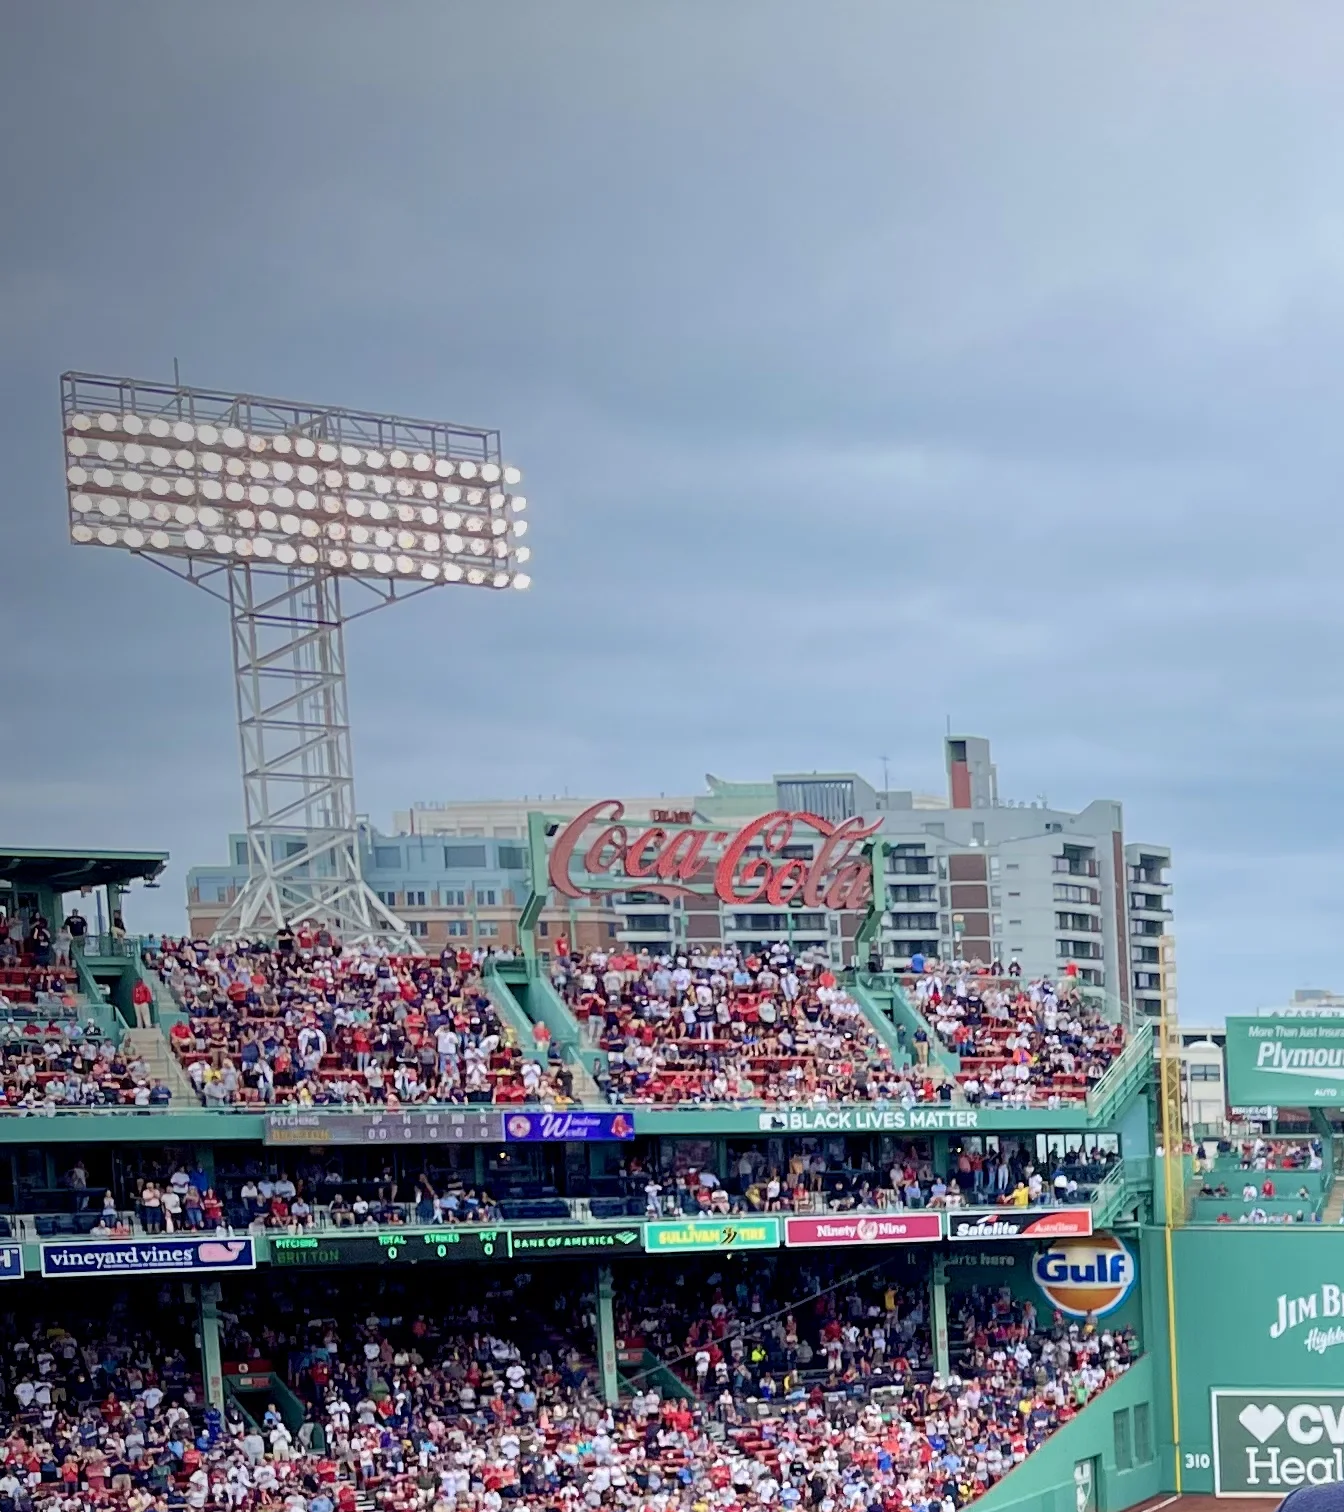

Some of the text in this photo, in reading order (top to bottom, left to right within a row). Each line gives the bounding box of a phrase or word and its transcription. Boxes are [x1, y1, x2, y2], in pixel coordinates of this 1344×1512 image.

[549, 800, 885, 909] Coca-Cola
[1248, 1026, 1272, 1037] More
[1275, 1026, 1297, 1037] Than
[1299, 1027, 1317, 1037] Just
[1314, 1088, 1337, 1097] AUTO
[789, 1111, 978, 1129] BLACK LIVES MATTER
[739, 1227, 766, 1242] TIRE
[816, 1223, 907, 1239] Ninety Nine
[275, 1238, 318, 1249] PITCHING
[378, 1235, 407, 1246] TOTAL
[513, 1235, 614, 1249] BANK OF AMERICA
[51, 1247, 194, 1270] vineyard vines
[387, 1246, 397, 1260] 0
[437, 1244, 446, 1257] 0
[484, 1242, 494, 1256] 0
[1037, 1253, 1125, 1283] Gulf
[1269, 1292, 1318, 1339] JIM
[1185, 1453, 1210, 1469] 310
